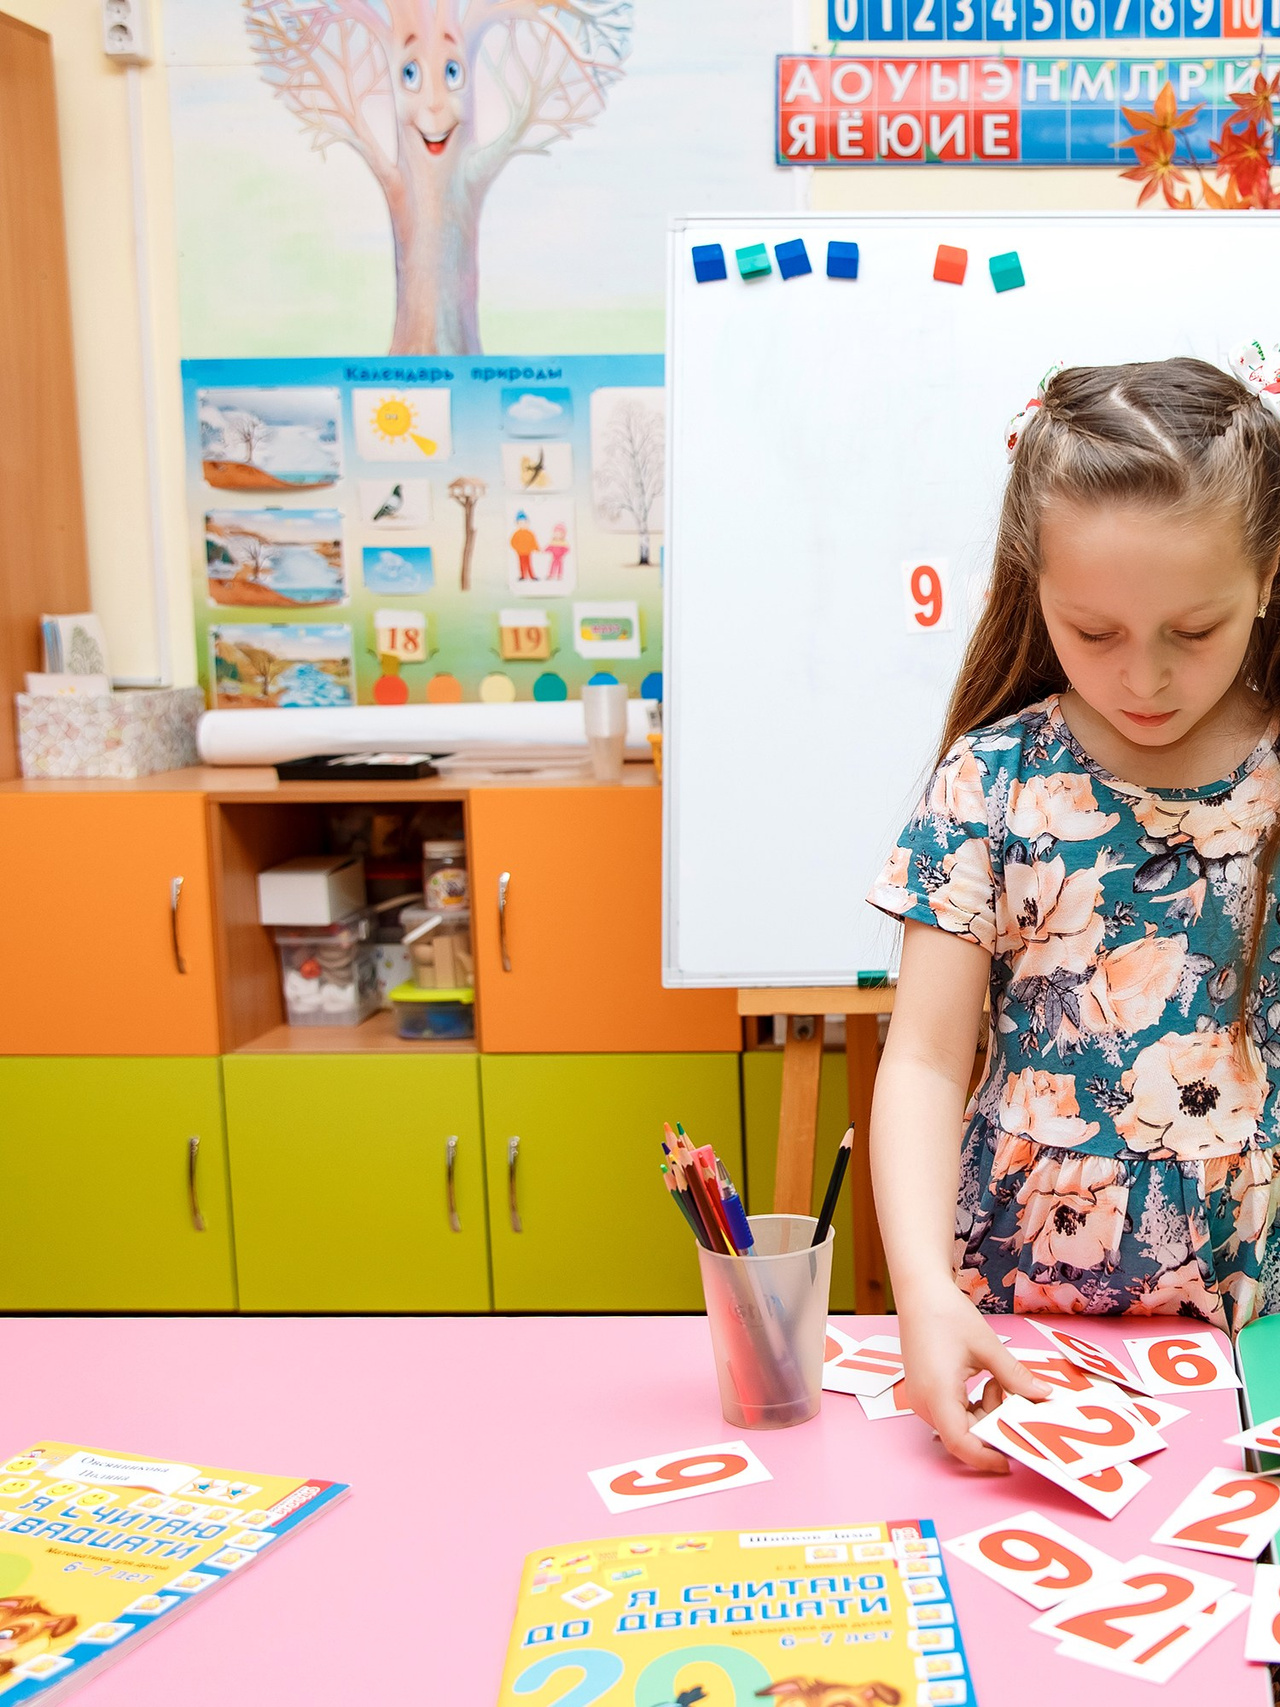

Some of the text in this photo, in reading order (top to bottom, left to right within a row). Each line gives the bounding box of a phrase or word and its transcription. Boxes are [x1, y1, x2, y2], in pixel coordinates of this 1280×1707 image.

[835, 0, 858, 32] 0
[880, 0, 893, 32] 1
[912, 0, 936, 32] 2
[952, 0, 975, 32] 3
[991, 0, 1017, 32] 4
[1032, 0, 1054, 32] 5
[1071, 0, 1095, 30] 6
[1112, 0, 1136, 30] 7
[1149, 0, 1175, 30] 8
[1190, 0, 1214, 30] 9
[1231, 0, 1261, 30] 10
[784, 63, 822, 103] А
[830, 62, 873, 103] О
[882, 62, 920, 102] У
[930, 62, 970, 102] Ы
[980, 62, 1014, 102] Э
[1027, 62, 1061, 102] Н
[1071, 62, 1115, 102] М
[1123, 63, 1160, 102] Л
[1179, 62, 1207, 101] Р
[787, 116, 816, 156] Я
[838, 110, 865, 156] Ё
[878, 115, 923, 157] Ю
[931, 115, 968, 156] И
[981, 115, 1012, 157] Е
[344, 366, 562, 383] Календарь природы
[911, 565, 943, 626] 9
[388, 627, 419, 652] 18
[511, 626, 542, 652] 19
[1148, 1339, 1218, 1387] 6
[1019, 1405, 1135, 1464] 2
[19, 1496, 55, 1512] Я
[1173, 1476, 1280, 1548] 2
[0, 1516, 203, 1560] ВАДЦАТИ
[979, 1529, 1093, 1590] 9
[628, 1575, 885, 1608] Я СЧИТАЮ
[1056, 1572, 1195, 1650] 2
[523, 1597, 888, 1646] ДО ДВАДЦАТИ
